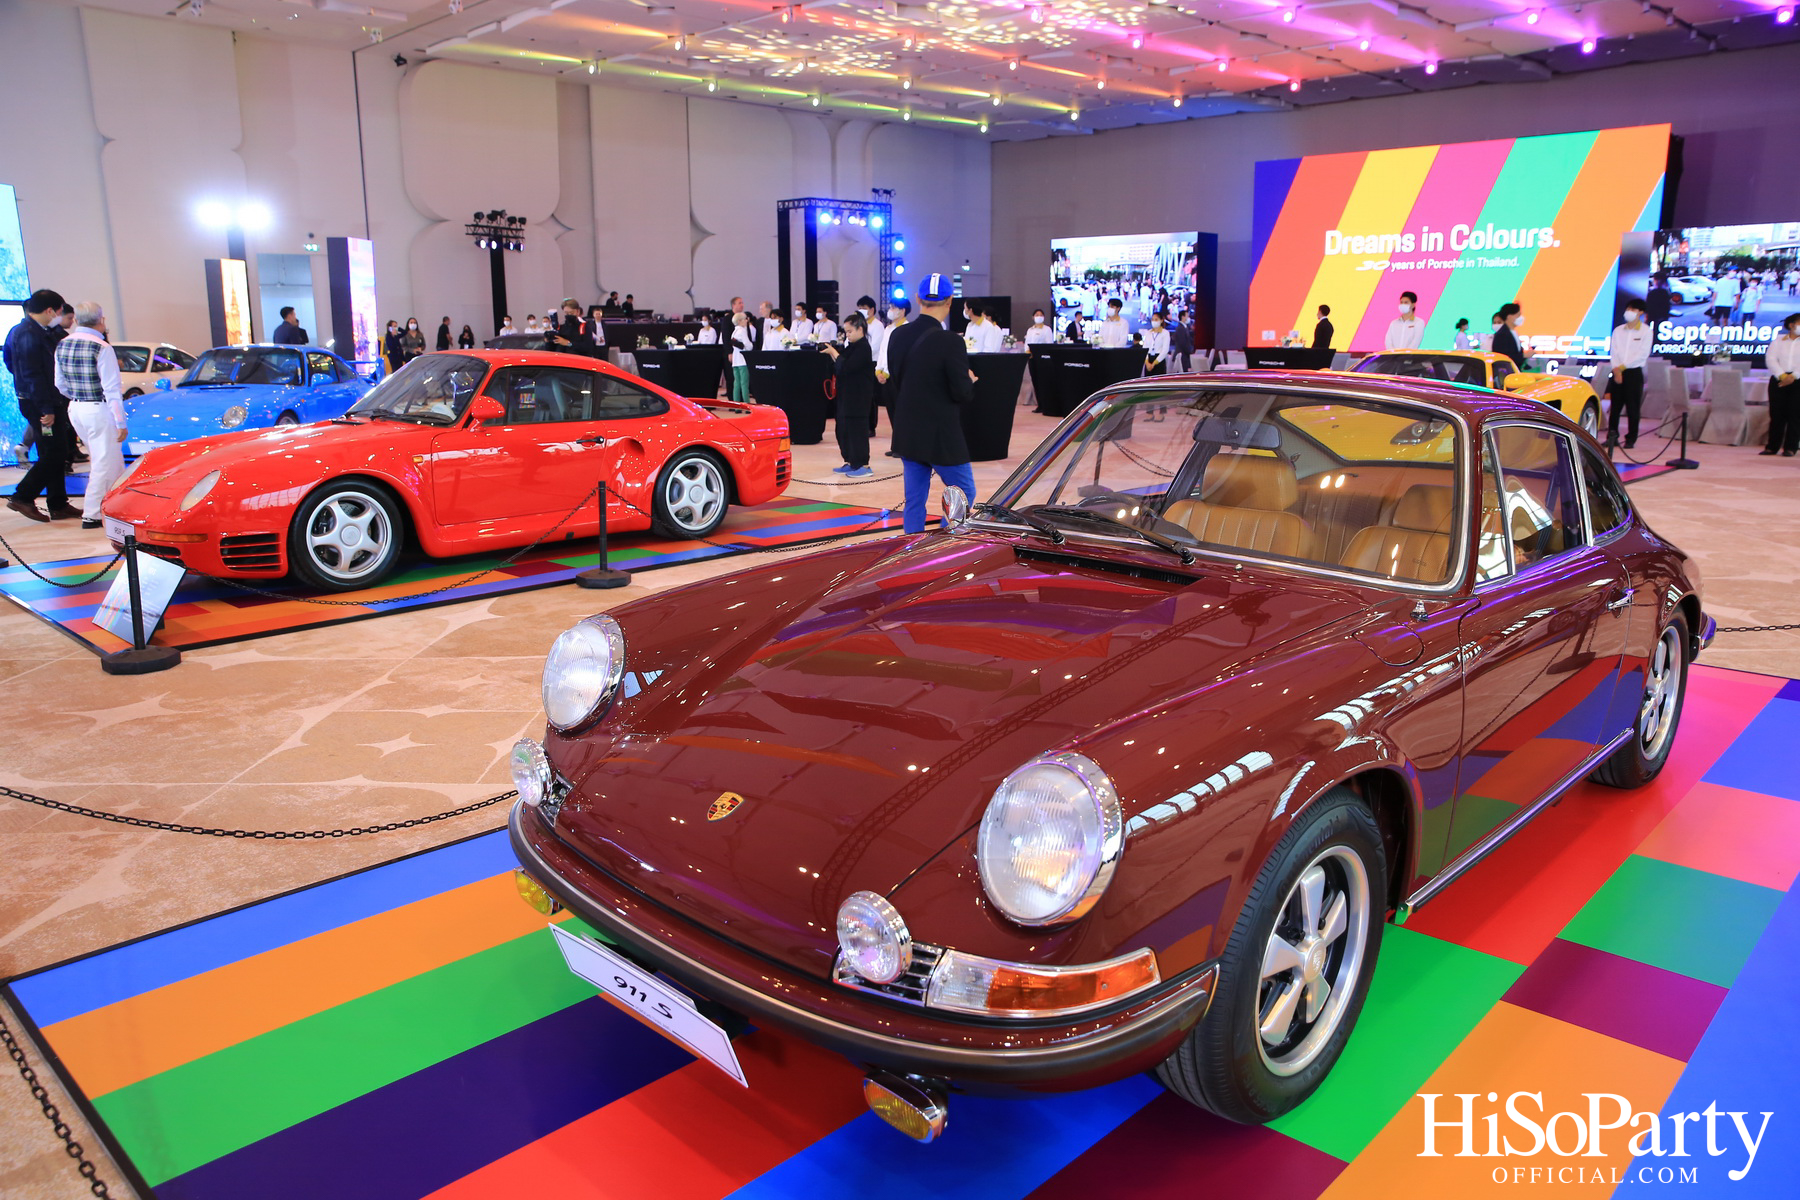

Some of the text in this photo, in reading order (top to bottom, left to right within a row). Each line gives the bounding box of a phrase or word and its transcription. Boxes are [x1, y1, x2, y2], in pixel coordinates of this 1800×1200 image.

[1325, 223, 1561, 255] Dreams in Colours.
[1391, 260, 1415, 272] years
[1416, 259, 1427, 270] of
[1427, 258, 1464, 270] Porsche
[1465, 257, 1475, 268] in
[1477, 256, 1520, 268] Thailand.
[613, 975, 648, 1003] 911
[651, 1002, 673, 1019] S
